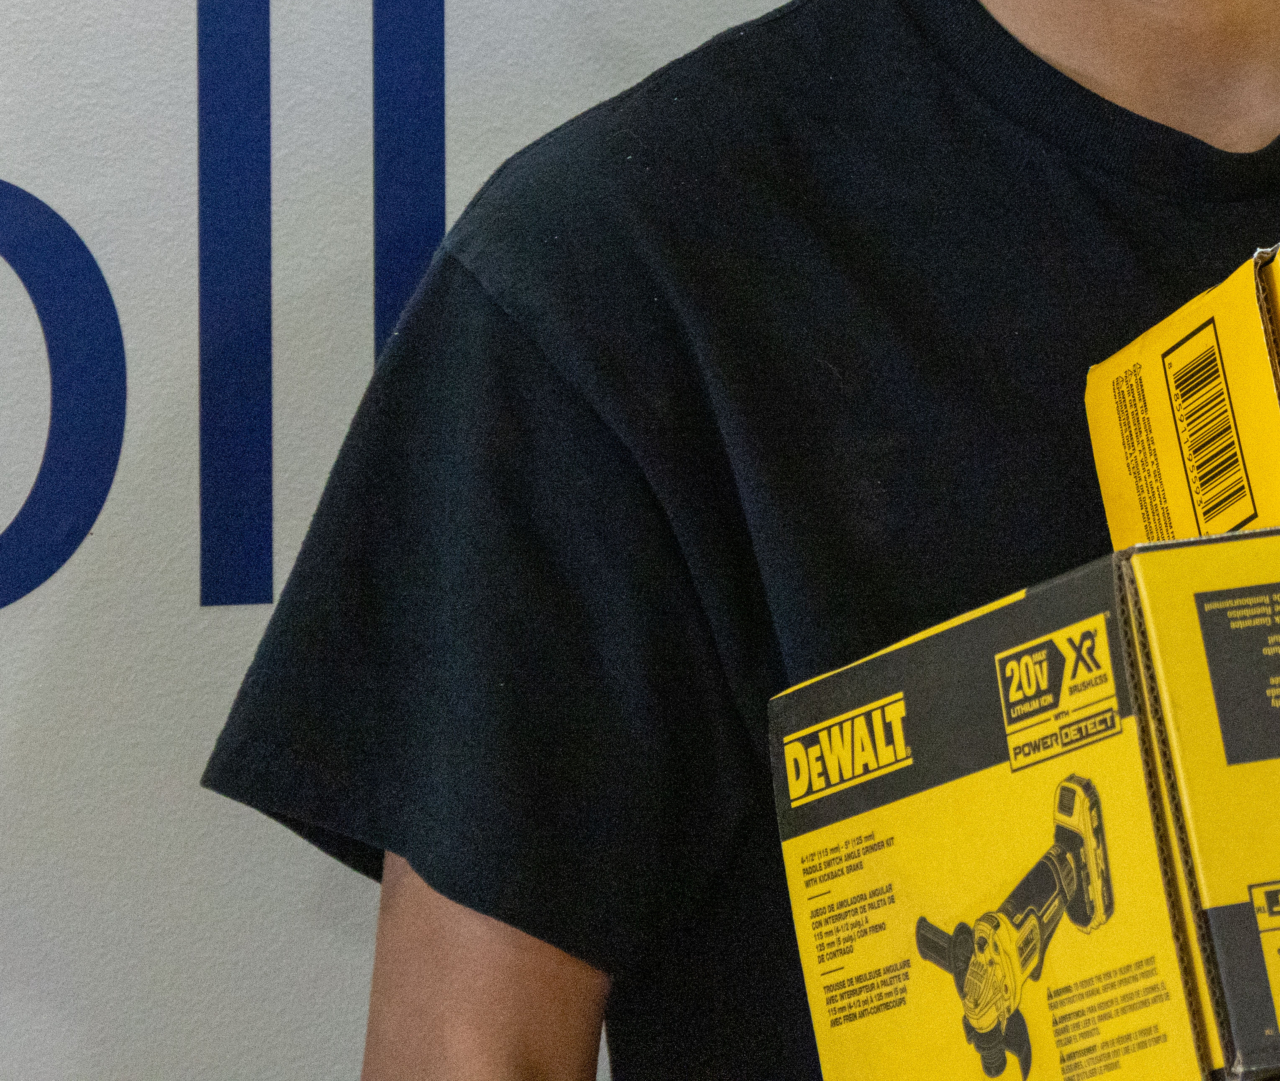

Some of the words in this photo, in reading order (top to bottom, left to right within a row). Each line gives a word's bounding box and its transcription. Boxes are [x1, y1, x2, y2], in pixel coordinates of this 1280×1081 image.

[1172, 392, 1190, 446] 85911
[1184, 452, 1203, 507] 95593
[1067, 629, 1101, 678] XR
[1009, 697, 1040, 719] LITHIUM
[1039, 692, 1054, 707] ION
[1067, 672, 1108, 697] BRUSHLESS
[1012, 731, 1060, 761] POWER
[1060, 711, 1114, 744] DETECT
[1053, 708, 1070, 722] WITH
[784, 704, 908, 800] DEWALT
